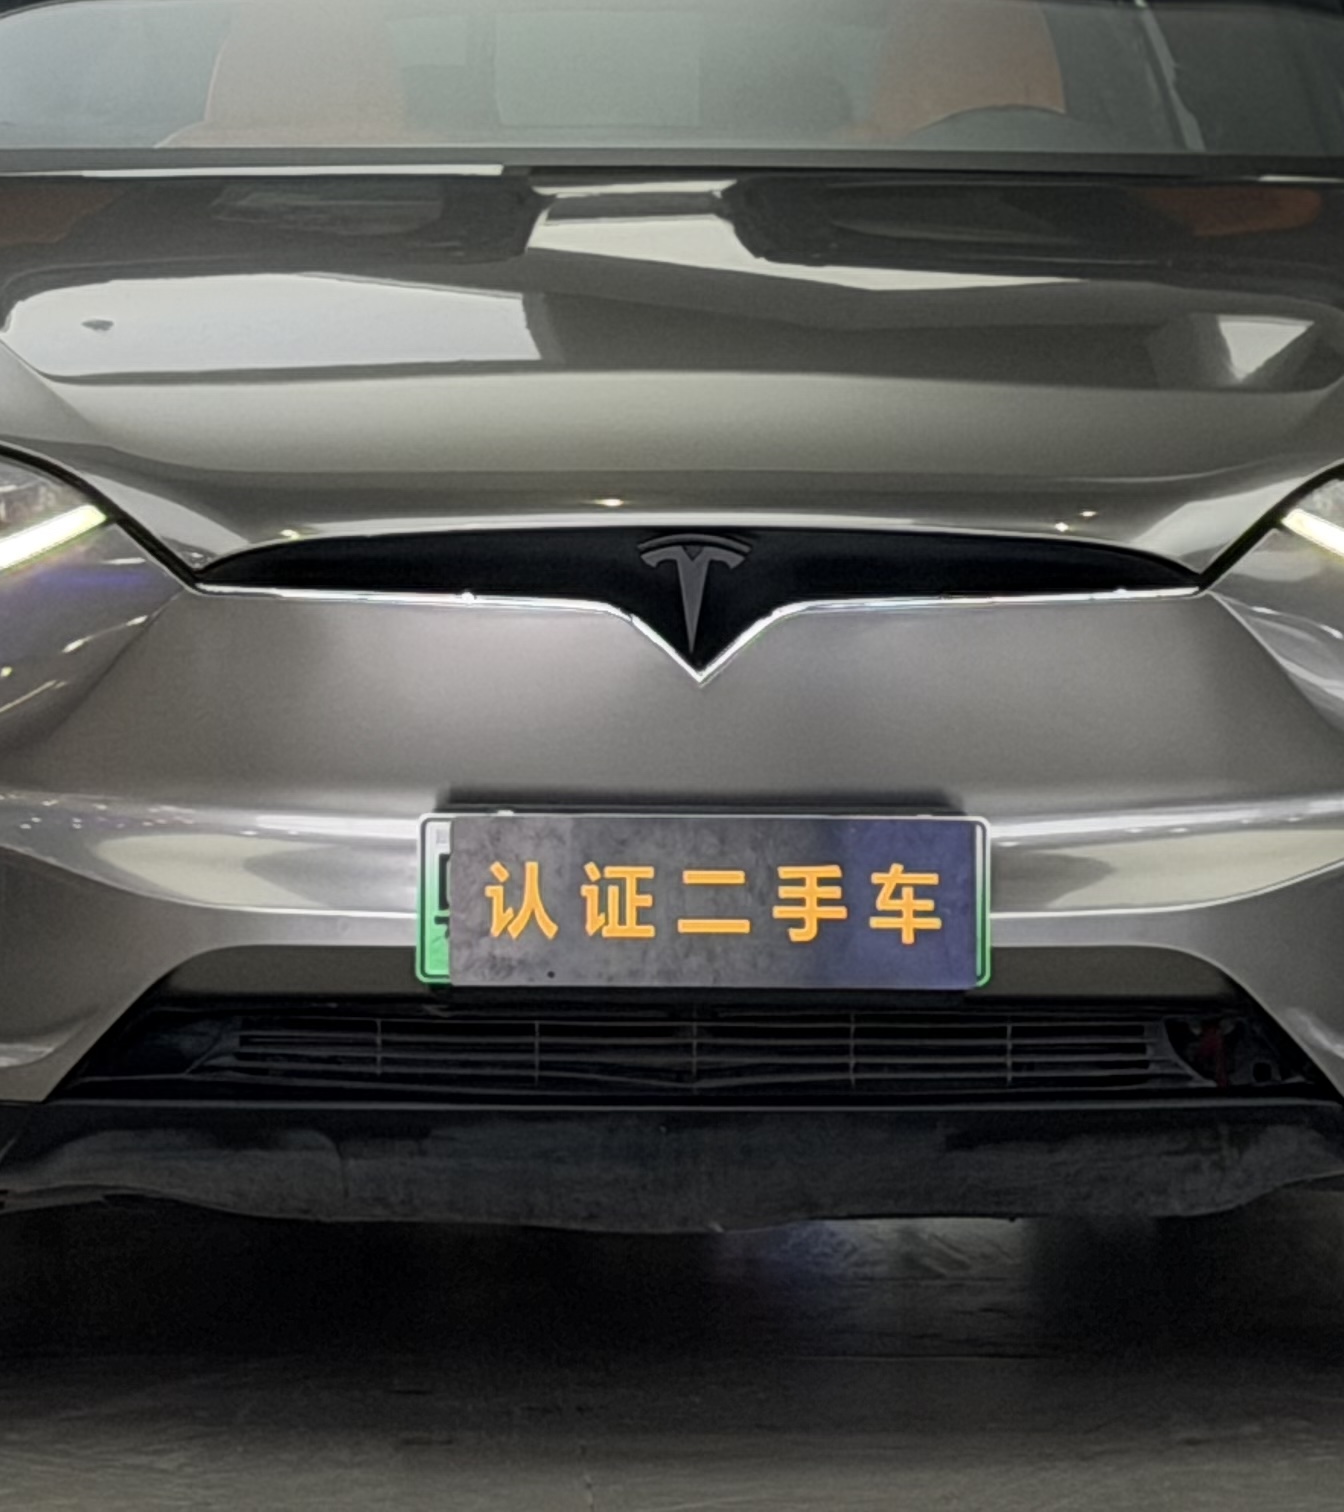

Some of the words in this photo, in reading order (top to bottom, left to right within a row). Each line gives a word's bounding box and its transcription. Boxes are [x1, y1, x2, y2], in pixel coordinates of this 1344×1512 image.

[484, 861, 943, 945] 认证二手车
